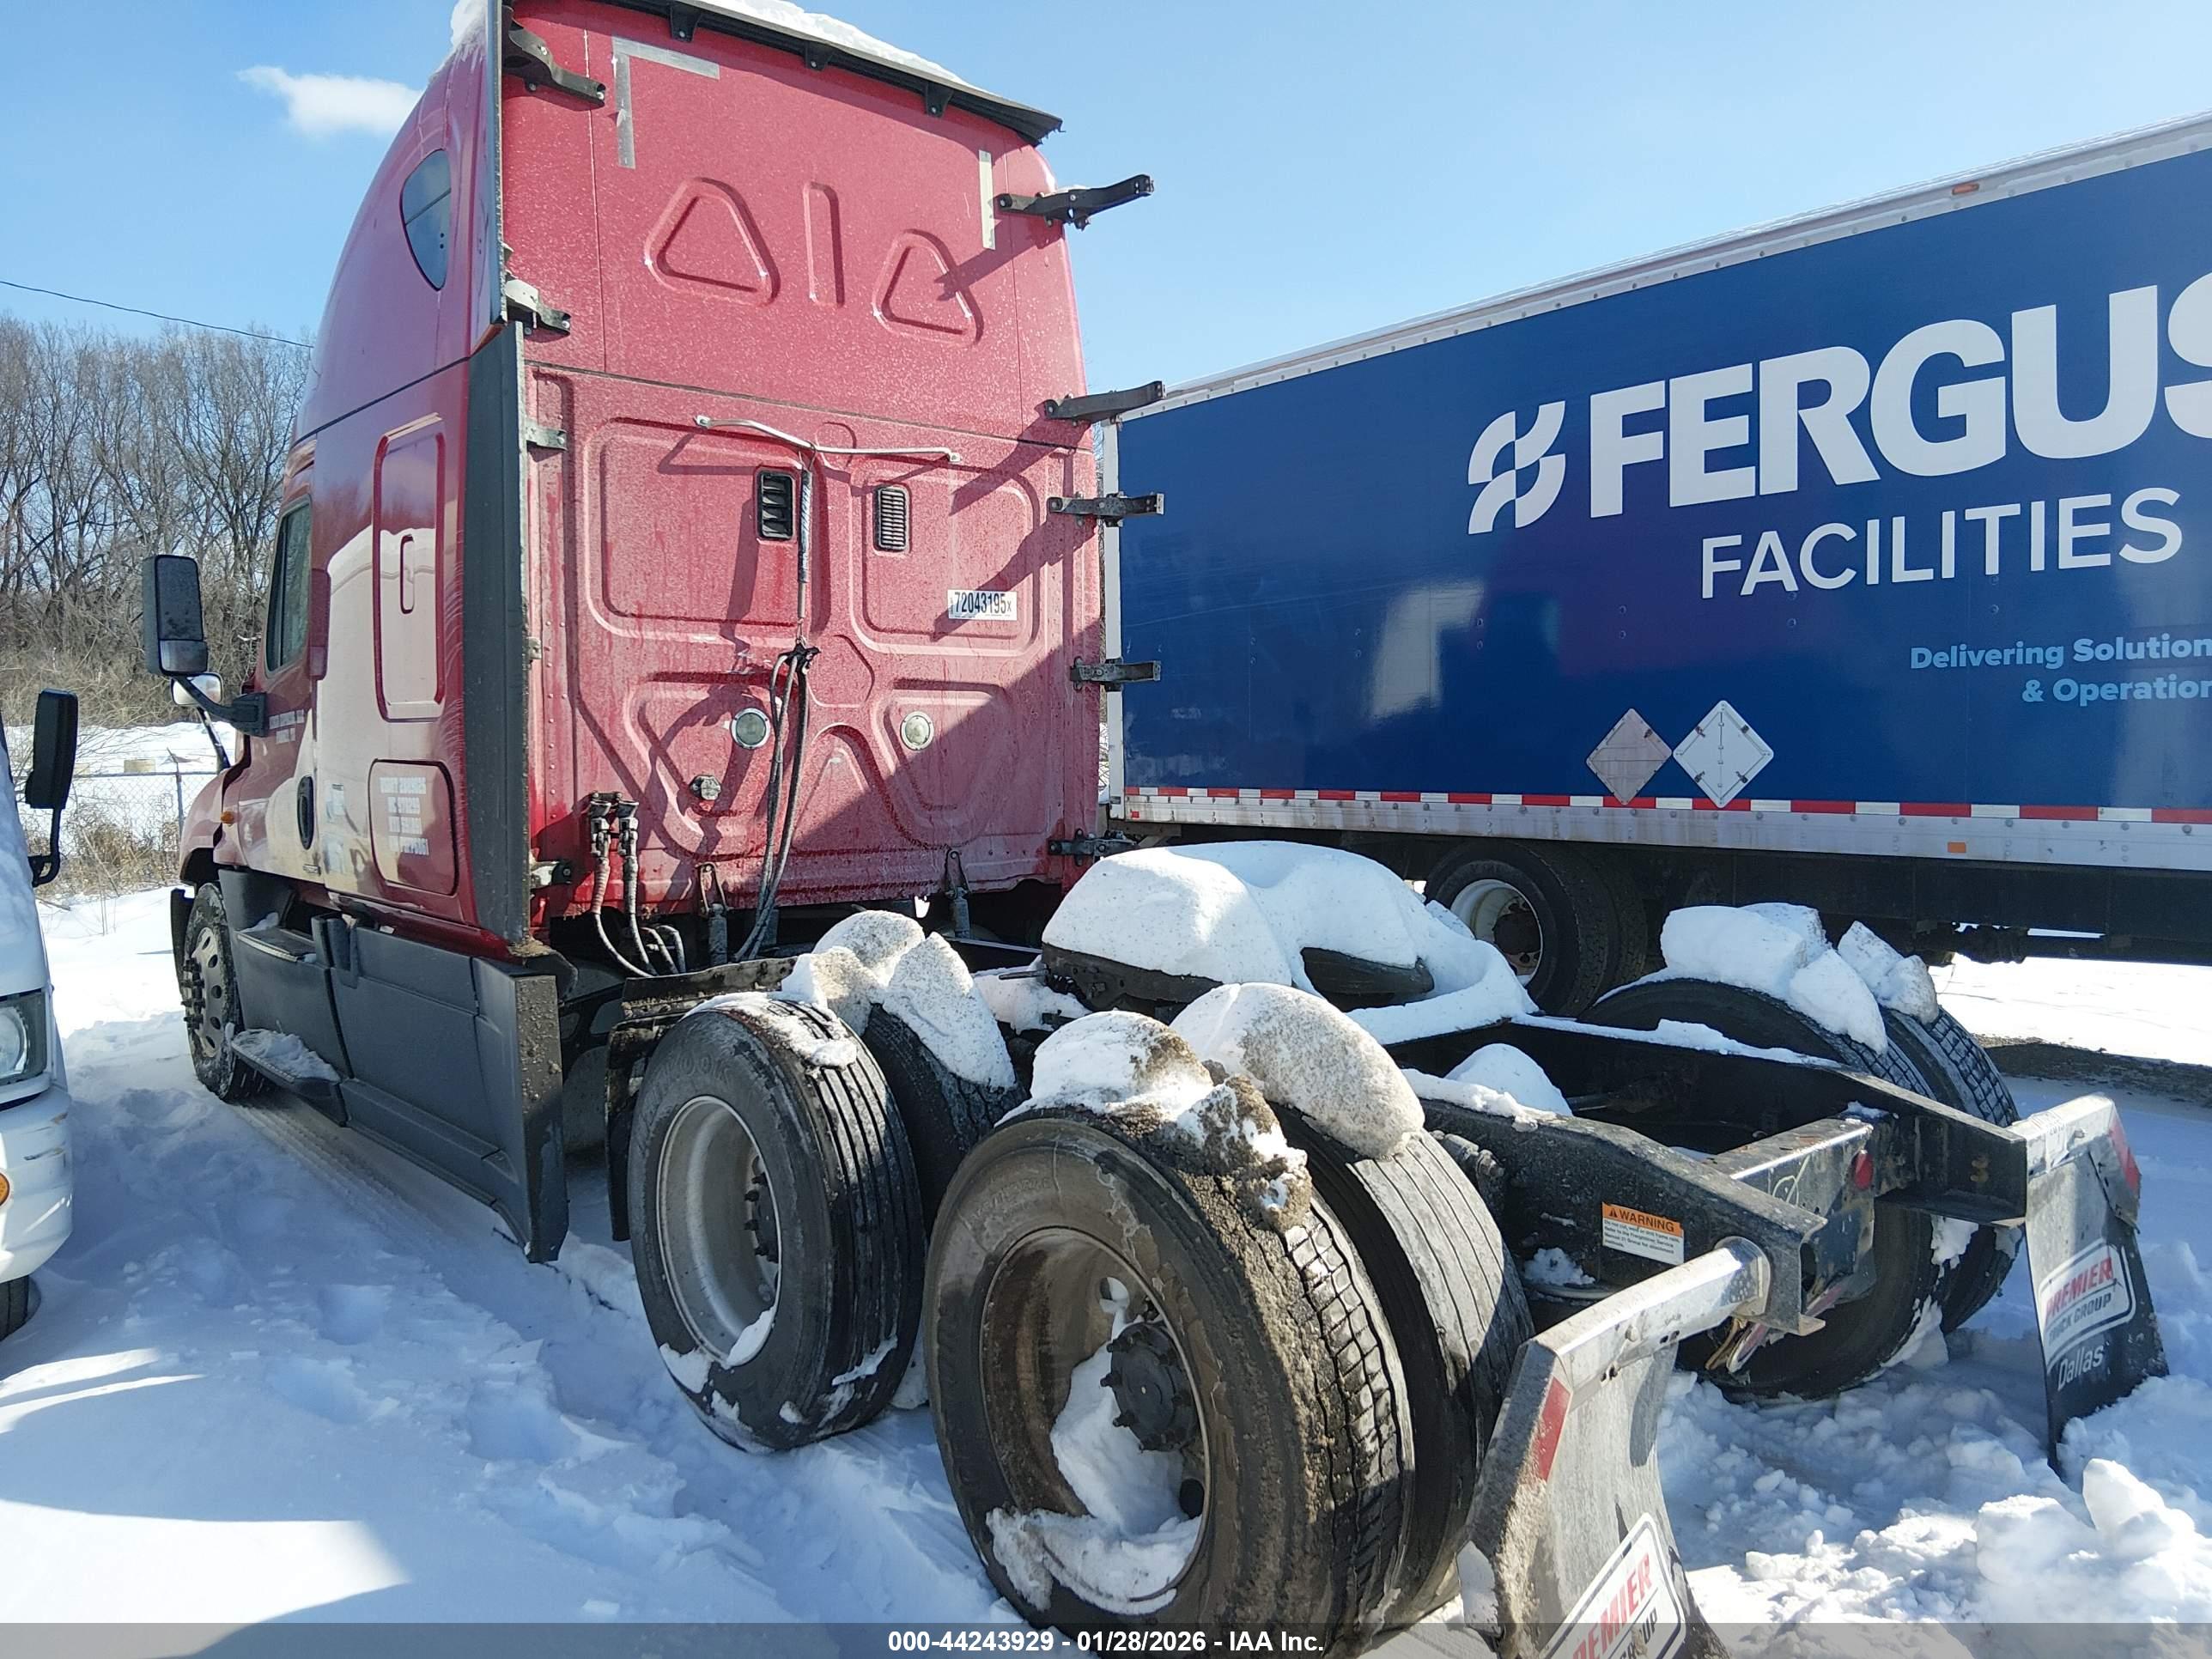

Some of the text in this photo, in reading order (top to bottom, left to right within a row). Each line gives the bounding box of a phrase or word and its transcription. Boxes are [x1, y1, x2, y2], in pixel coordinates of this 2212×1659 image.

[1701, 488, 2182, 599] FACILITIES
[1911, 641, 2064, 669] Delivering
[2021, 679, 2045, 702] &
[1619, 1208, 1674, 1232] WARNING
[2045, 1257, 2114, 1327] PREMIER
[2075, 1292, 2112, 1323] GROUP
[2057, 1344, 2105, 1391] Dallas
[1572, 1553, 1653, 1659] EMIER
